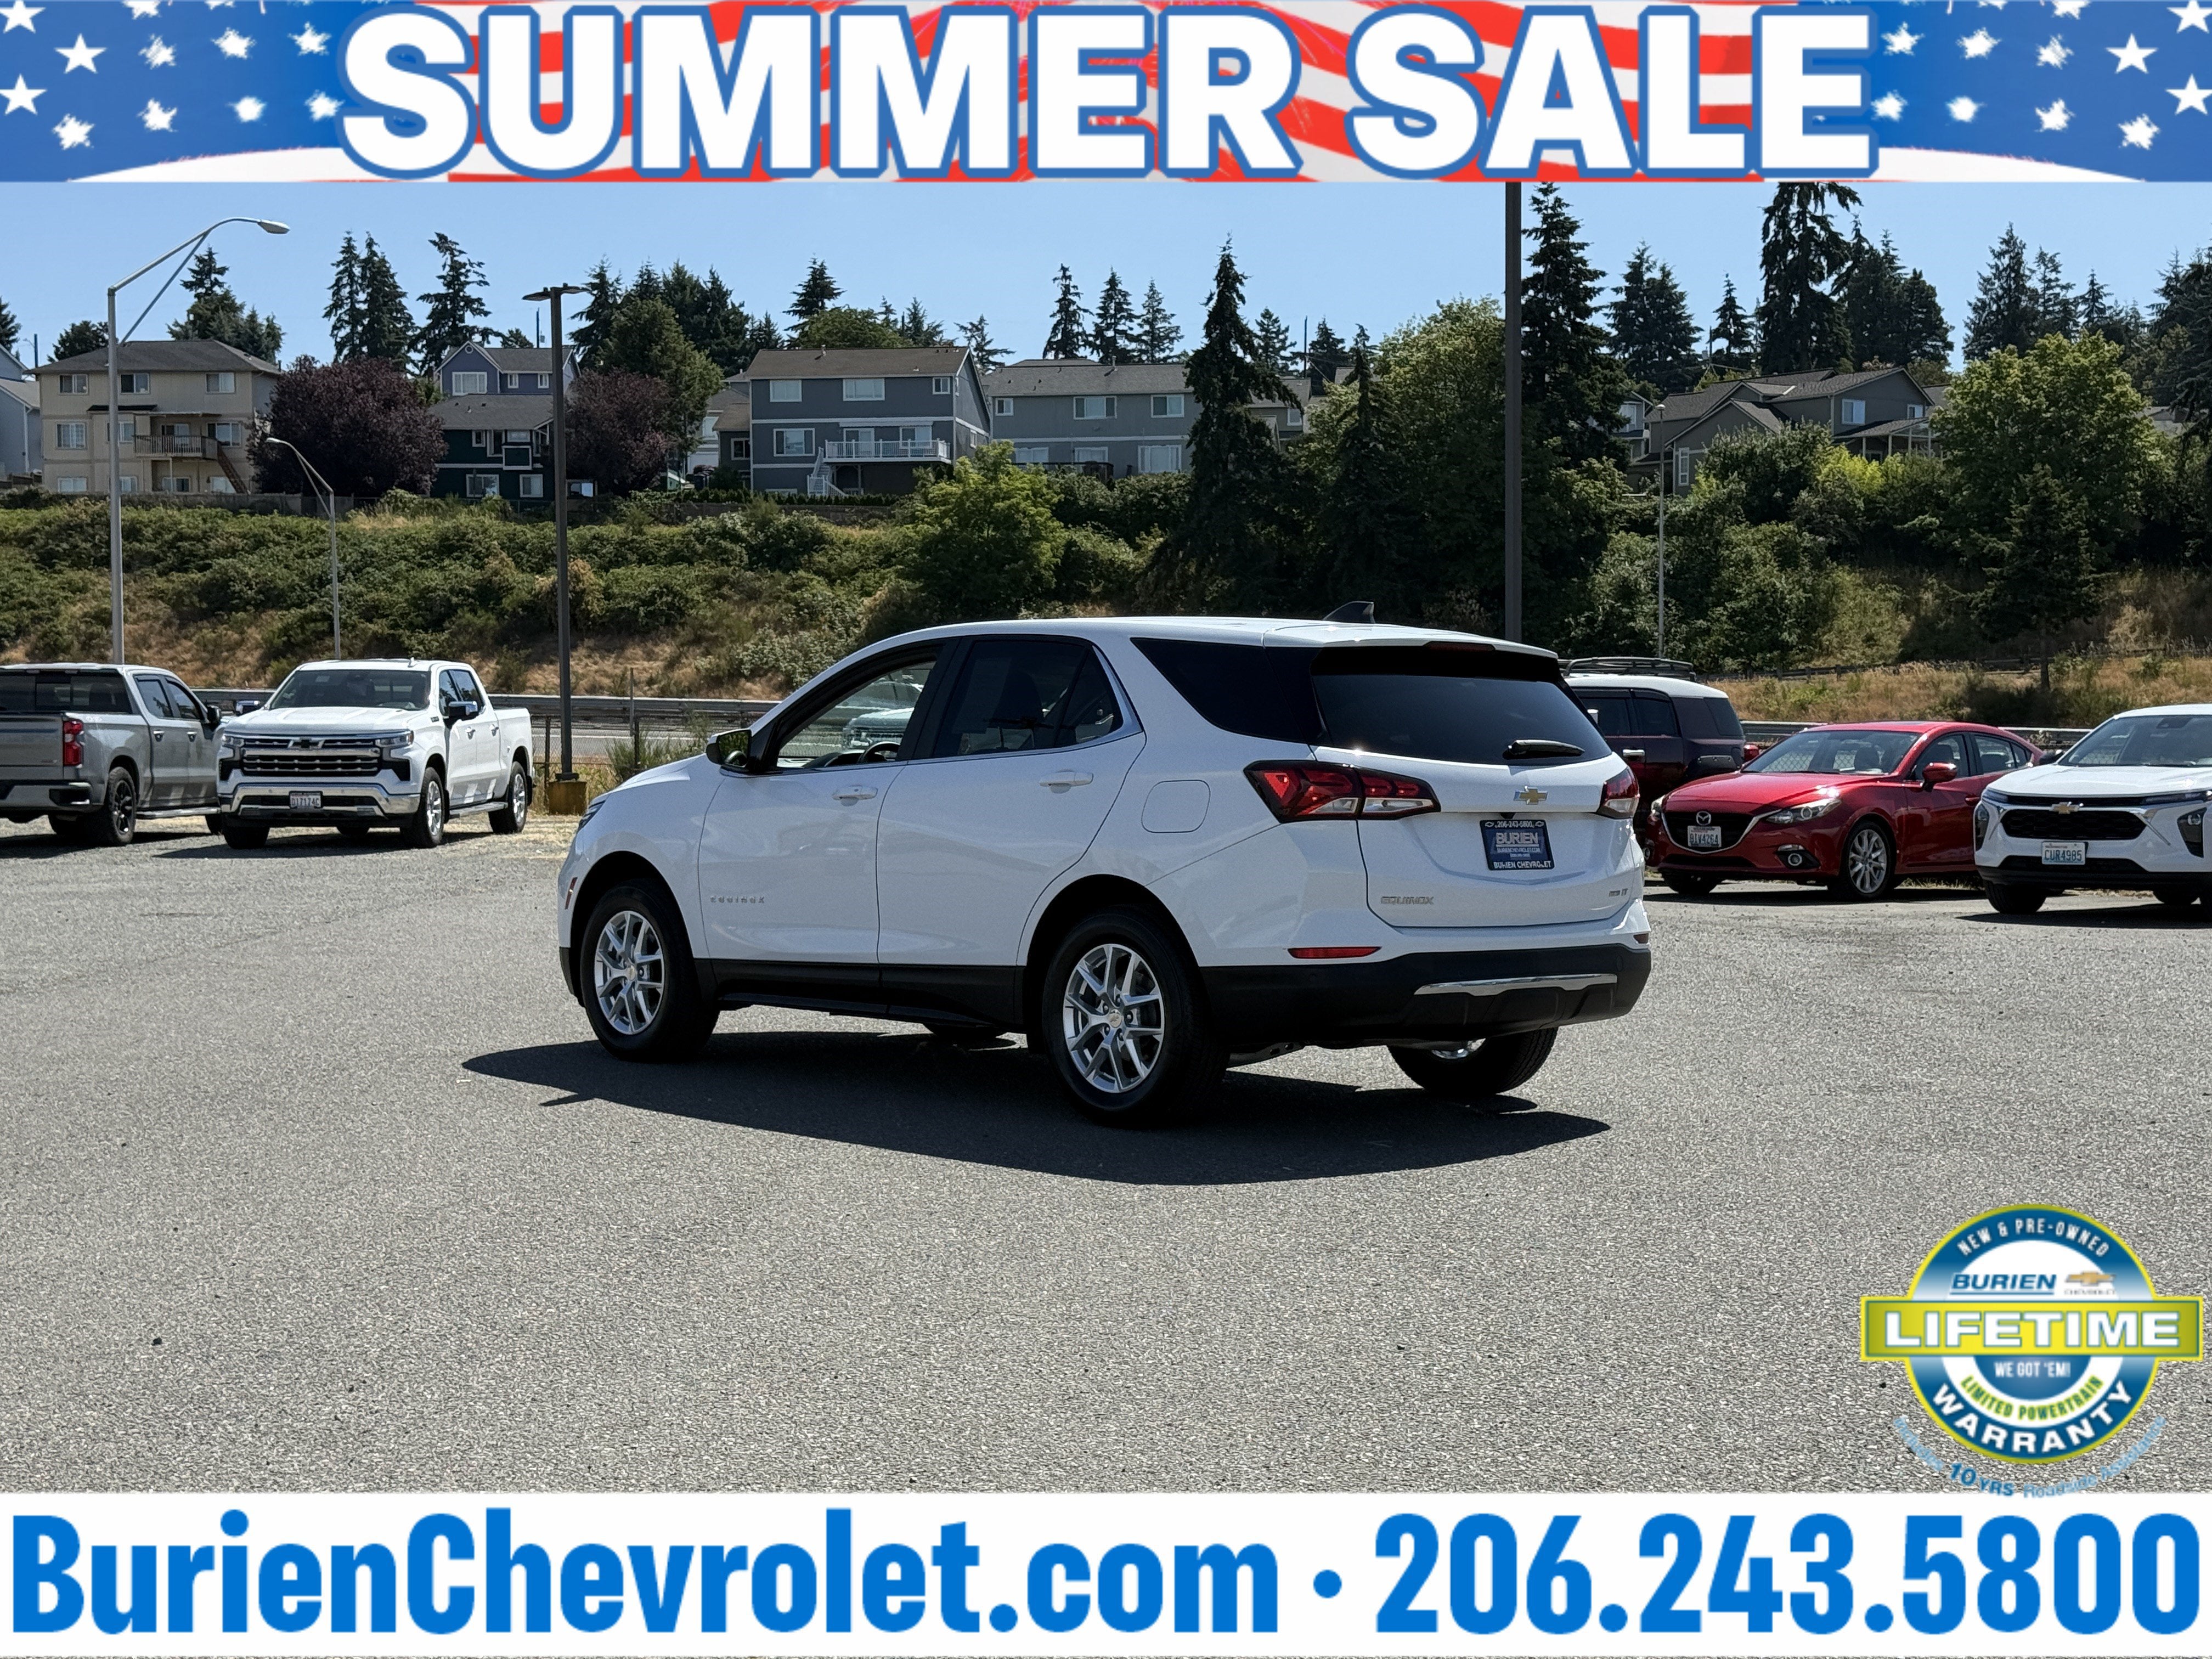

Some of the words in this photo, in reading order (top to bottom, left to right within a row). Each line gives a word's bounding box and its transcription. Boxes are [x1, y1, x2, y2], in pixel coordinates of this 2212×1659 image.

[1496, 832, 1538, 844] BURIEN
[2045, 850, 2083, 861] CUR4985
[1380, 896, 1434, 905] EQUINOX
